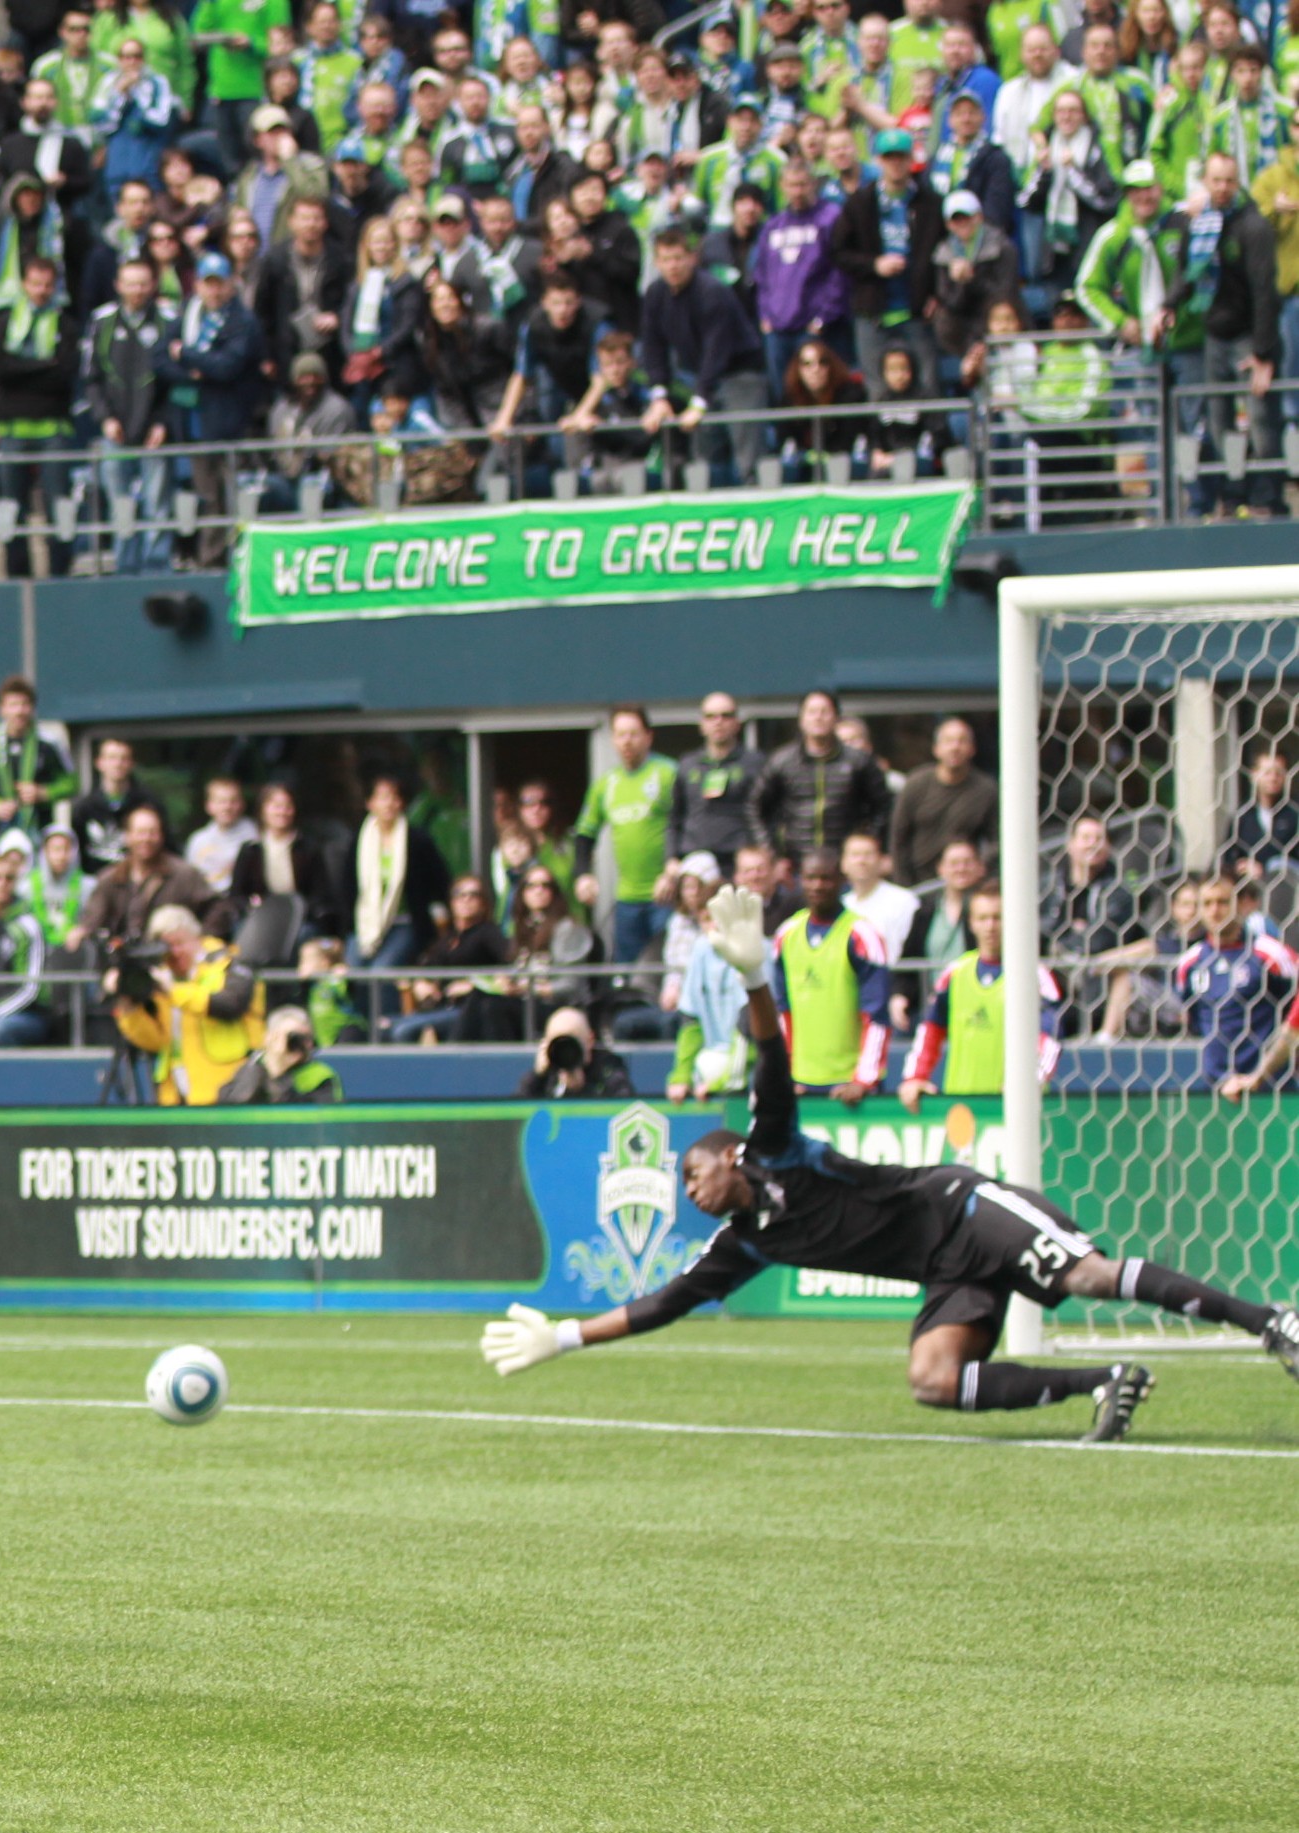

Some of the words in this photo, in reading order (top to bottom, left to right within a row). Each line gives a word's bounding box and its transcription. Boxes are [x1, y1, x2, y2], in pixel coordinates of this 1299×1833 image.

[273, 533, 496, 595] WELCOME
[522, 528, 584, 578] TO
[603, 518, 775, 575] GREEN
[789, 513, 919, 567] HELL
[20, 1147, 74, 1200] FOR
[75, 1147, 177, 1200] TICKETS
[179, 1146, 216, 1200] TO
[219, 1147, 270, 1199] THE
[272, 1146, 342, 1199] NEXT
[343, 1144, 437, 1198] MATCH
[75, 1206, 142, 1259] VISIT
[143, 1205, 383, 1260] SOUNDERSFC.COM
[1018, 1232, 1068, 1289] 25
